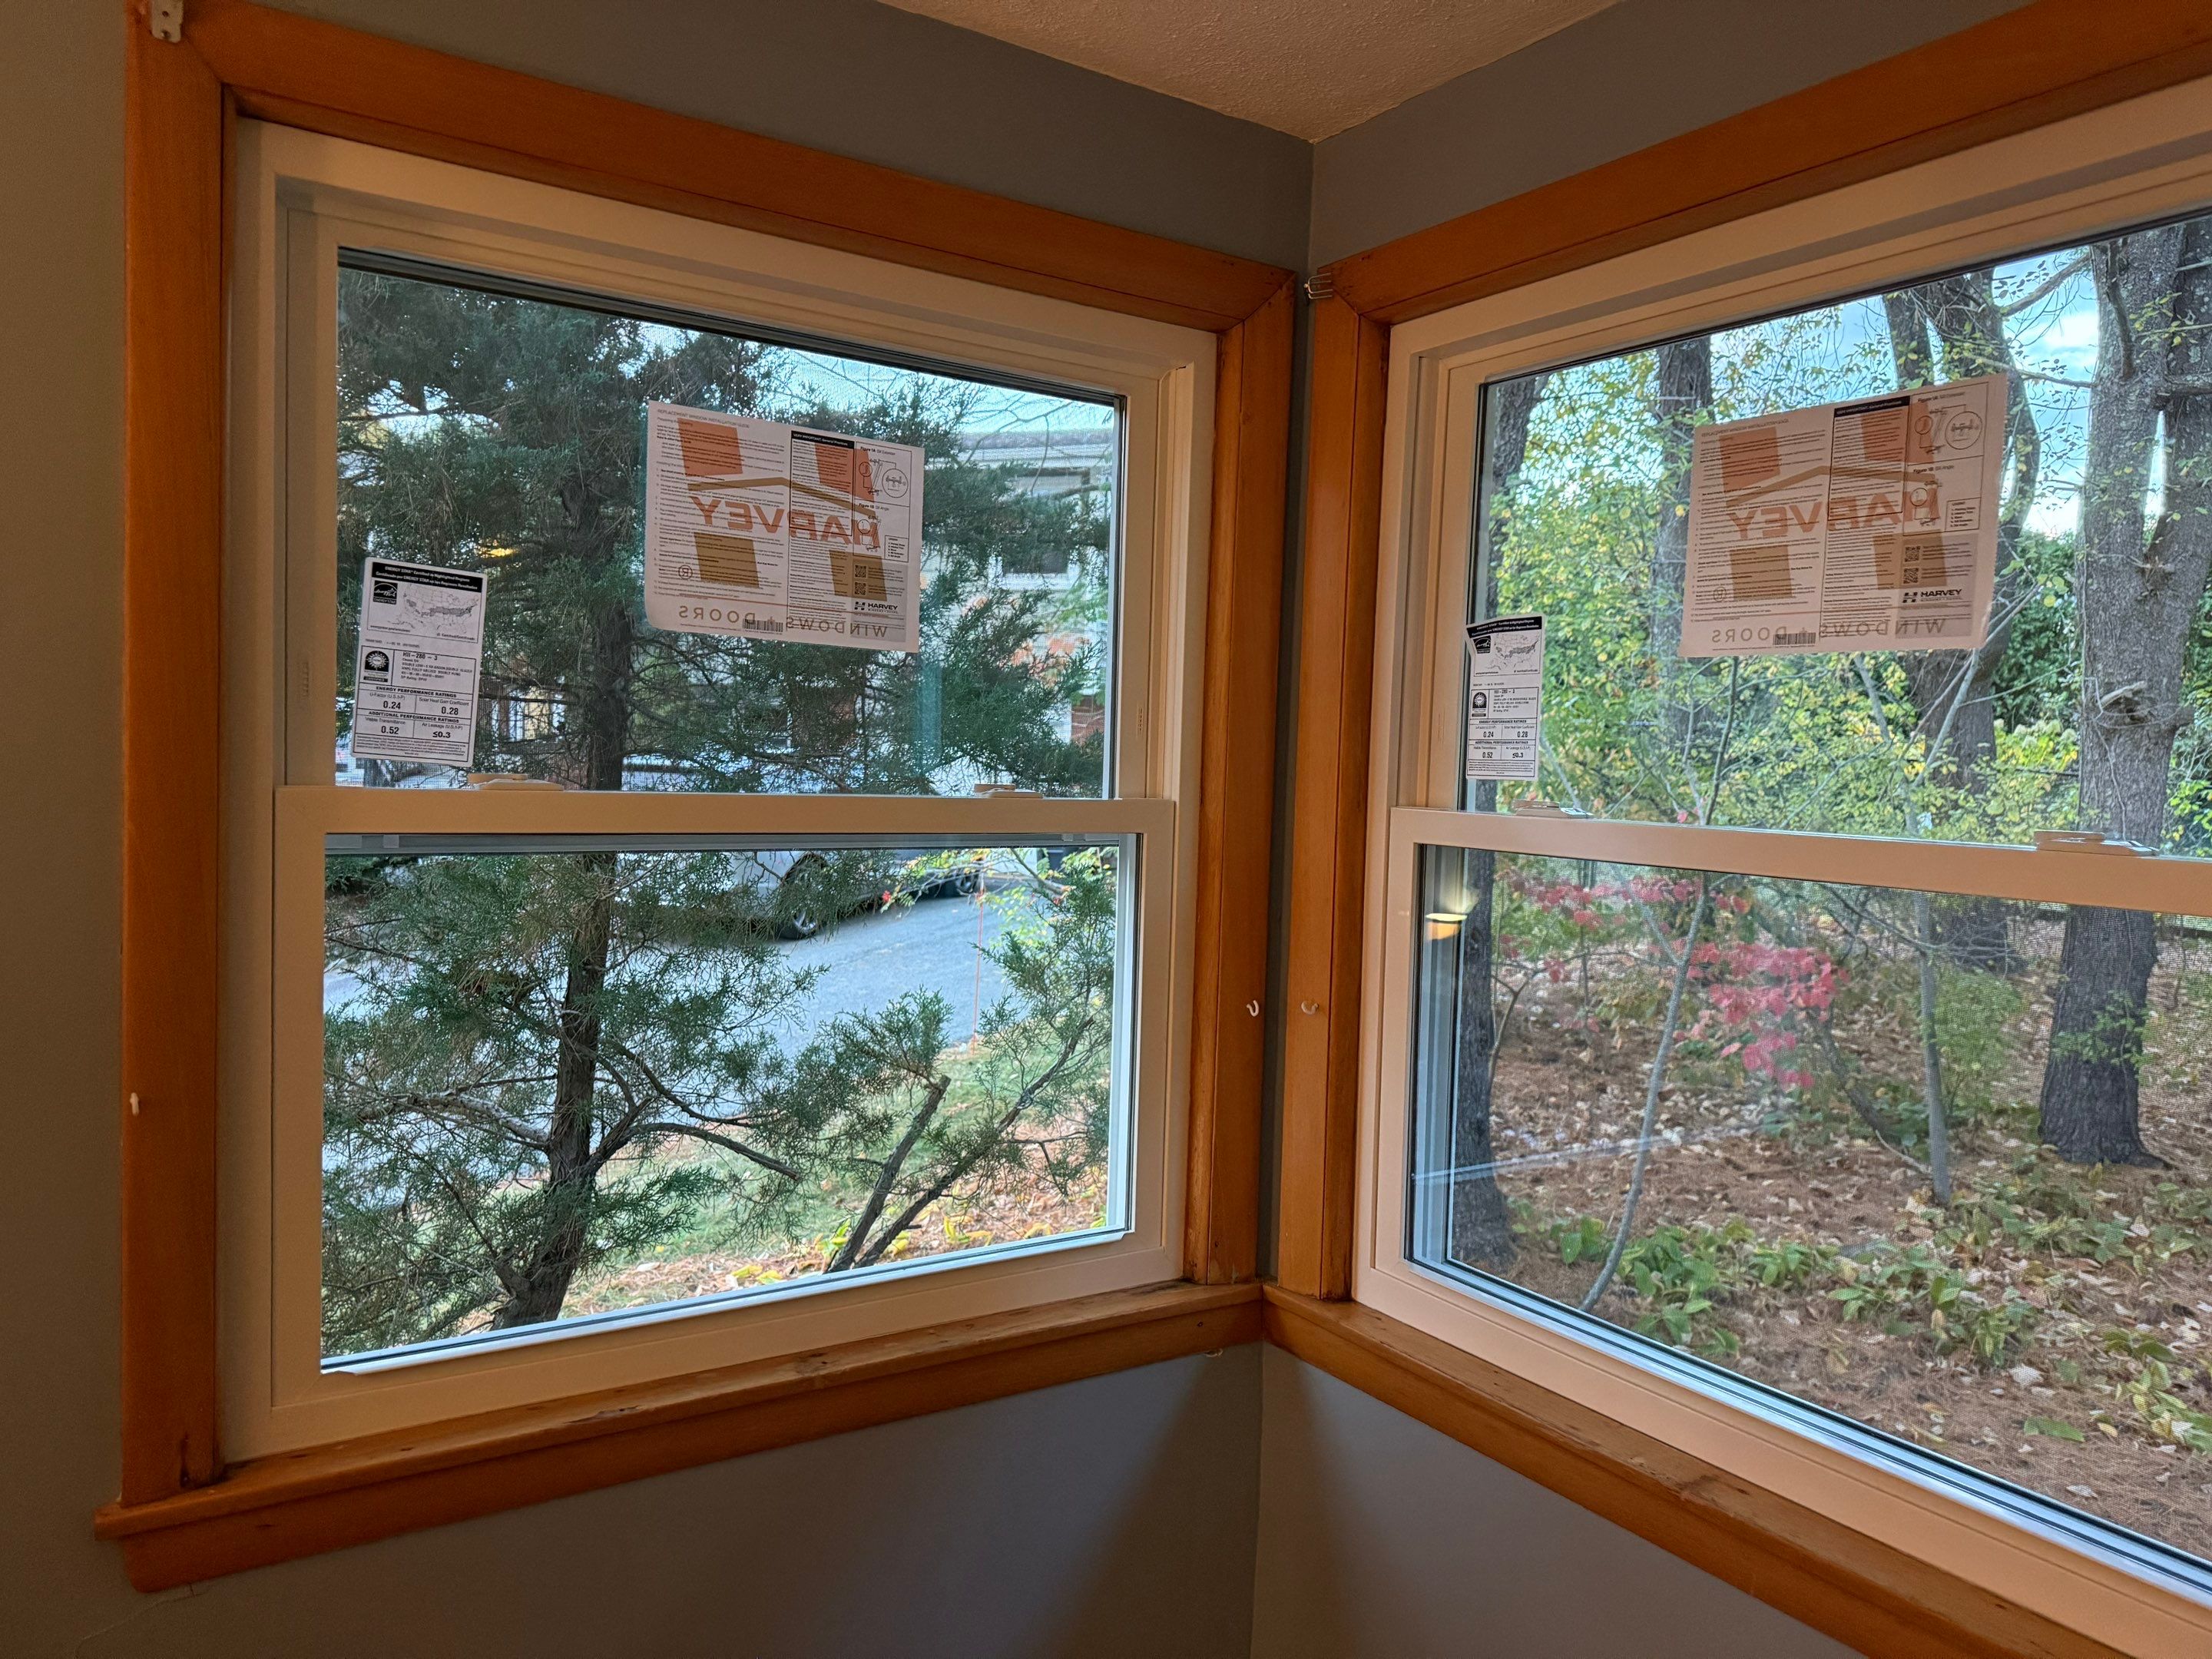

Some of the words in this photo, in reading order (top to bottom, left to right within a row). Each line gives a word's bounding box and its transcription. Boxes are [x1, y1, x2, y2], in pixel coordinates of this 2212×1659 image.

[383, 700, 401, 710] 0.24
[442, 706, 459, 715] 0.28
[381, 726, 399, 734] 0.52
